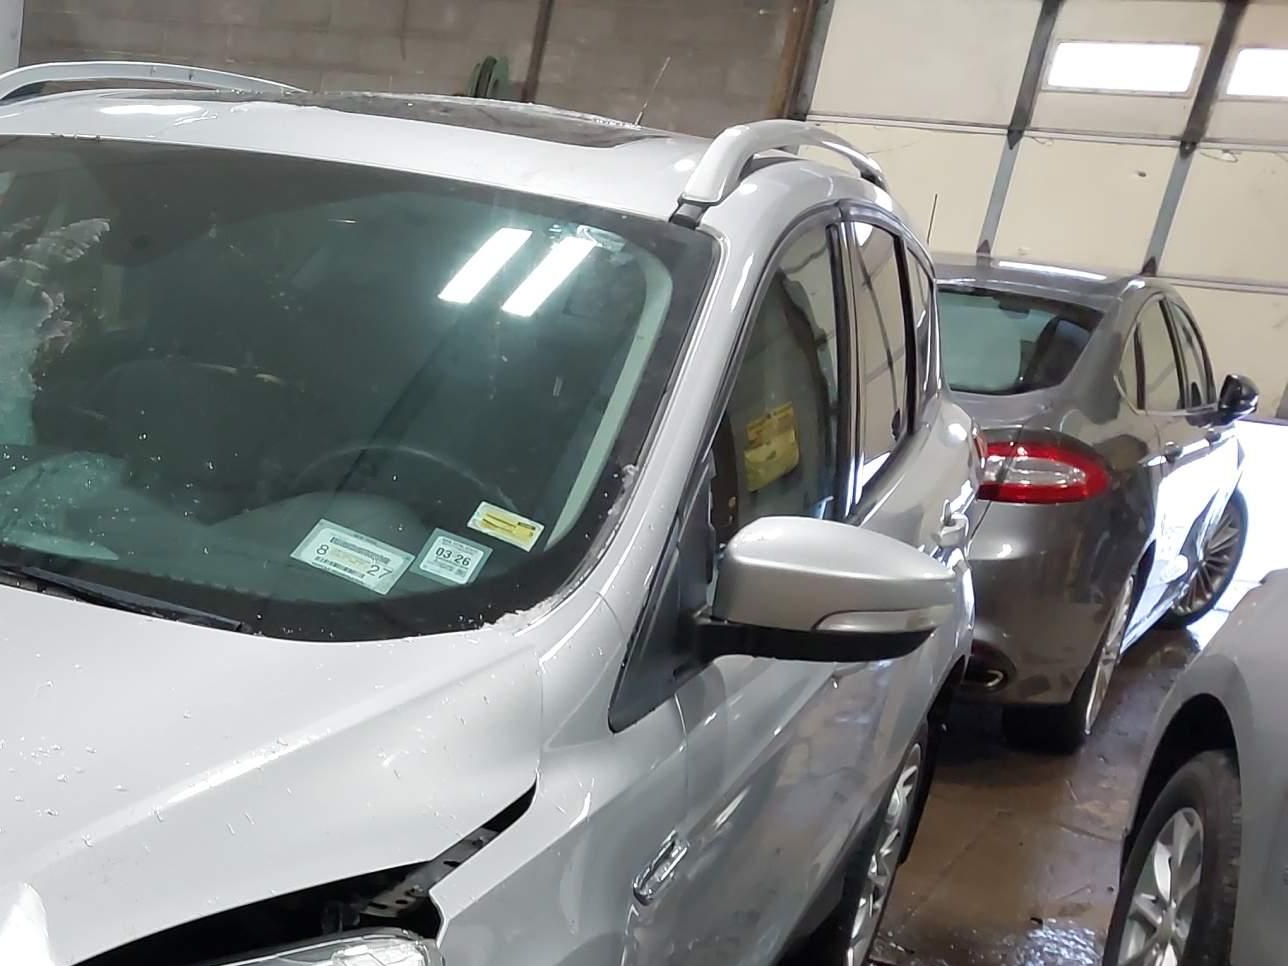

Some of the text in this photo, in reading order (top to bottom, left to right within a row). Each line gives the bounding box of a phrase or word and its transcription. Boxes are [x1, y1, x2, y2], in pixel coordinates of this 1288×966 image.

[316, 544, 329, 556] 8
[435, 547, 452, 559] 03
[454, 553, 472, 567] 26
[366, 564, 393, 579] 27
